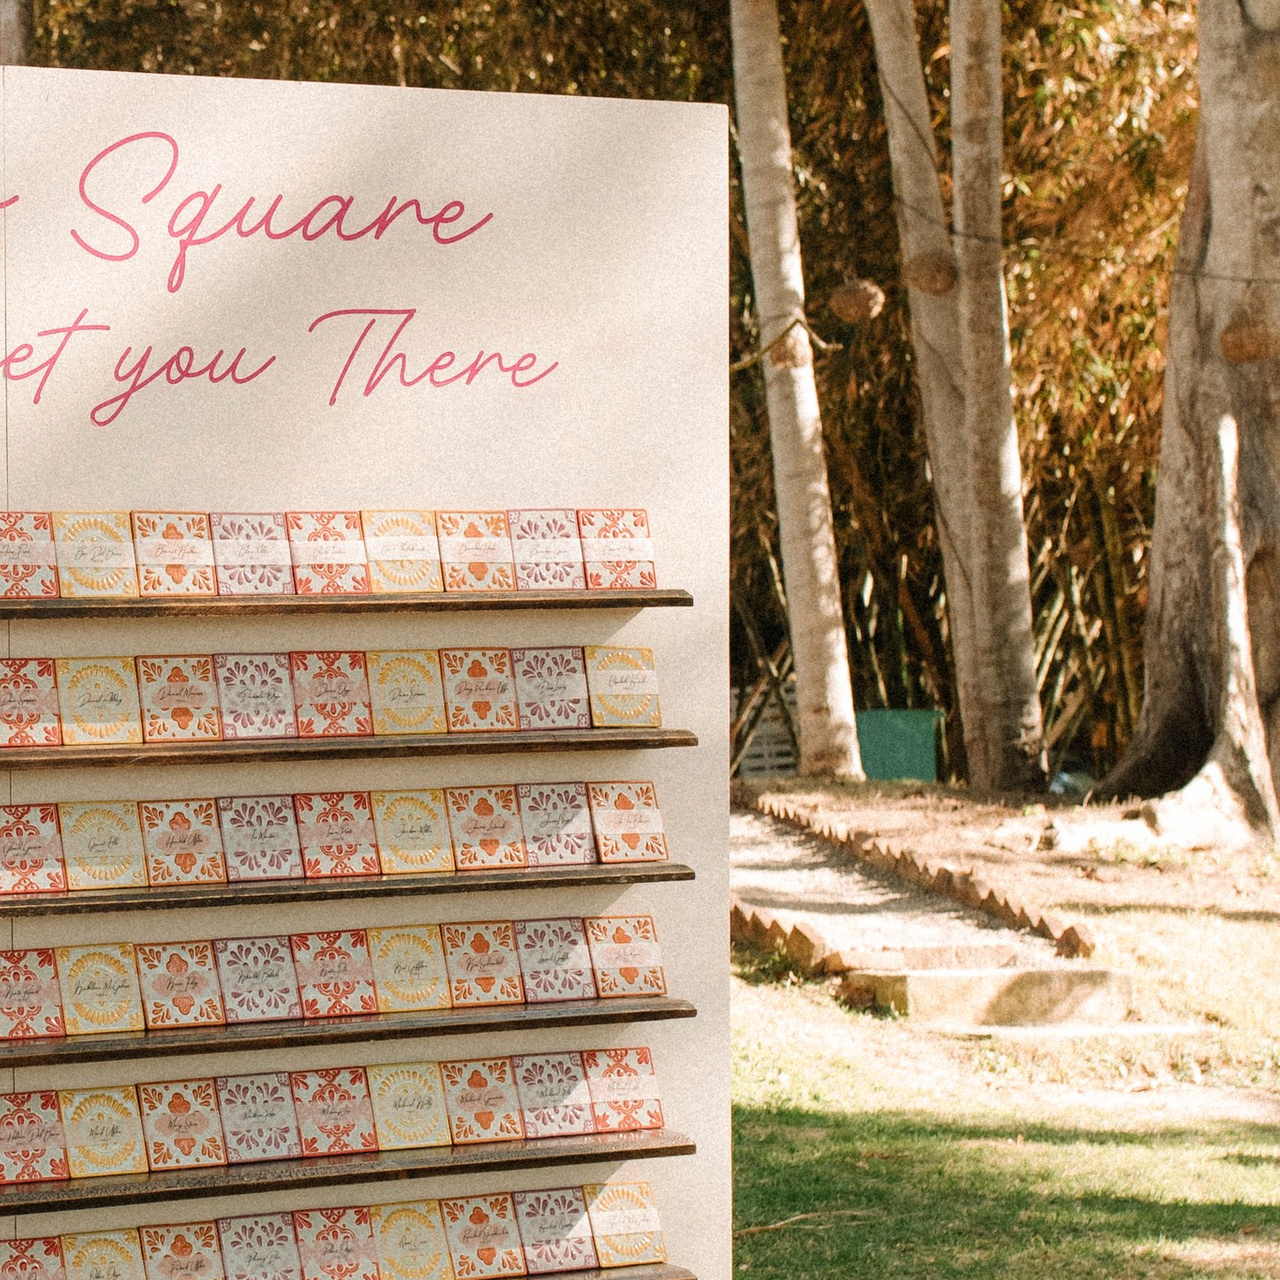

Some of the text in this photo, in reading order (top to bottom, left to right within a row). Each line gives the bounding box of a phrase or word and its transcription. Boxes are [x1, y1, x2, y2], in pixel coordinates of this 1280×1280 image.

[70, 131, 493, 293] Square
[90, 346, 276, 427] you
[309, 308, 558, 406] There
